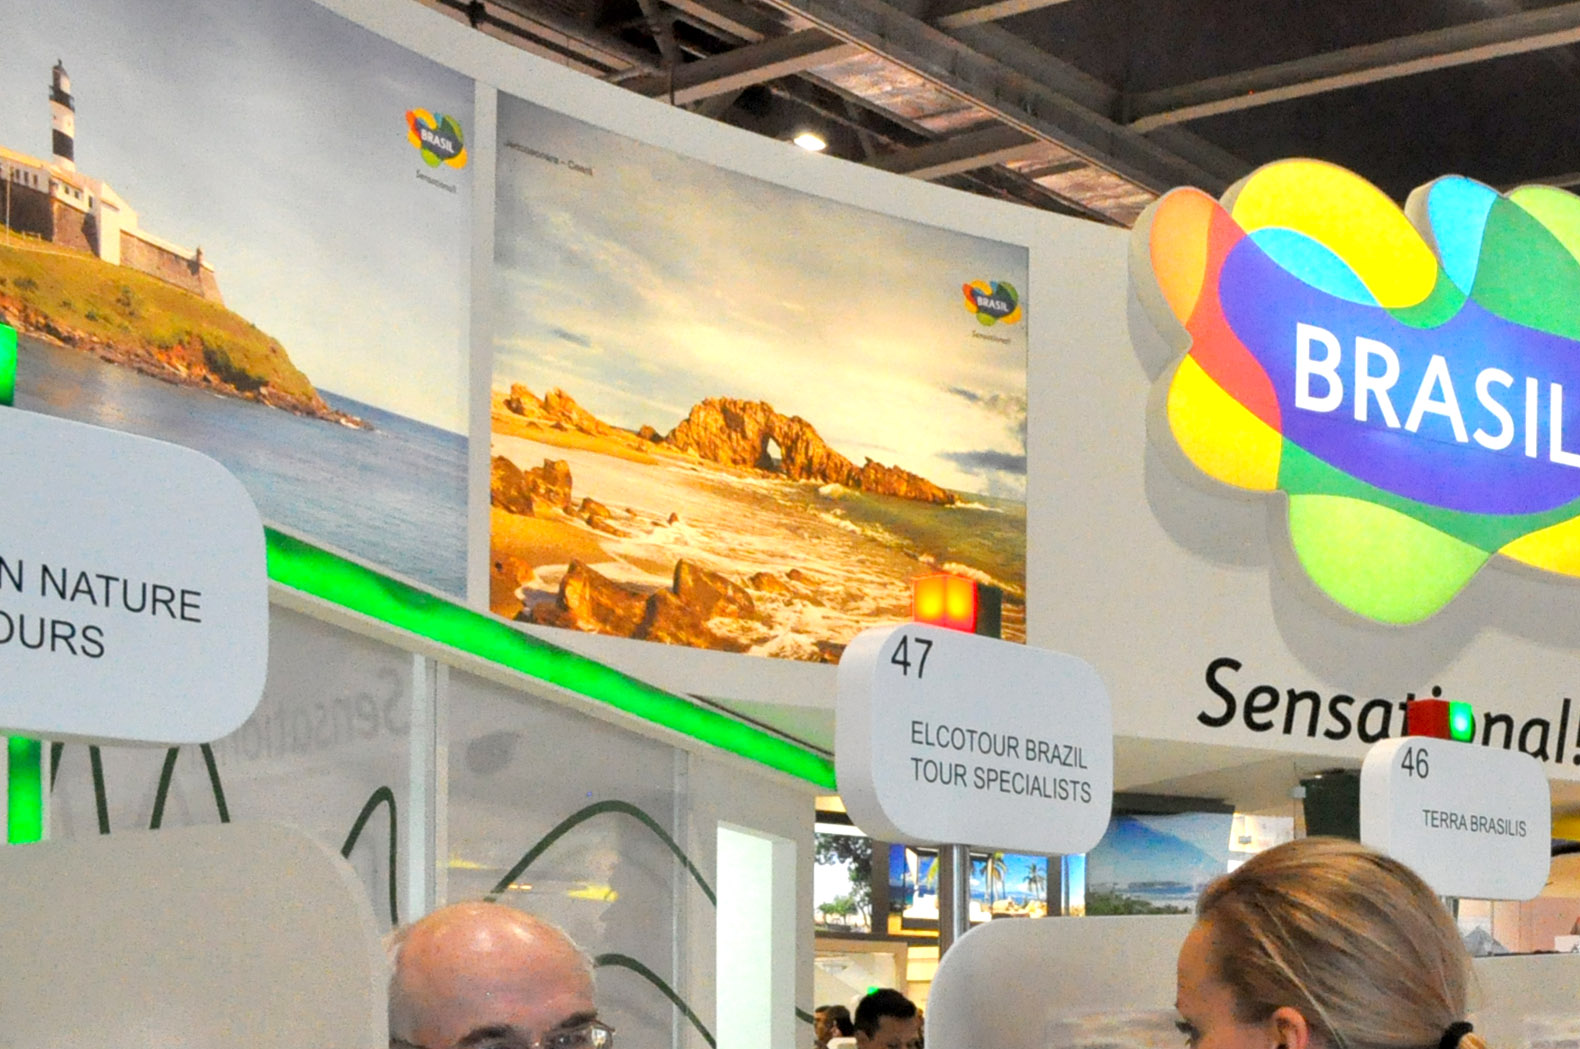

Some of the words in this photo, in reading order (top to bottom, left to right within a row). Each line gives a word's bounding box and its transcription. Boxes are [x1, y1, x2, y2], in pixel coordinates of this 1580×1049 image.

[420, 128, 455, 154] BRASIL
[976, 295, 1010, 313] BRASIL
[40, 563, 202, 624] NATURE
[890, 634, 934, 680] 47
[910, 720, 1020, 760] ELCOTOUR
[1025, 738, 1088, 770] BRAZIL
[1400, 746, 1430, 779] 46
[910, 757, 968, 788] TOUR
[973, 766, 1093, 804] SPECIALISTS
[1421, 808, 1468, 831] TERRA
[1470, 814, 1528, 838] BRASILIS
